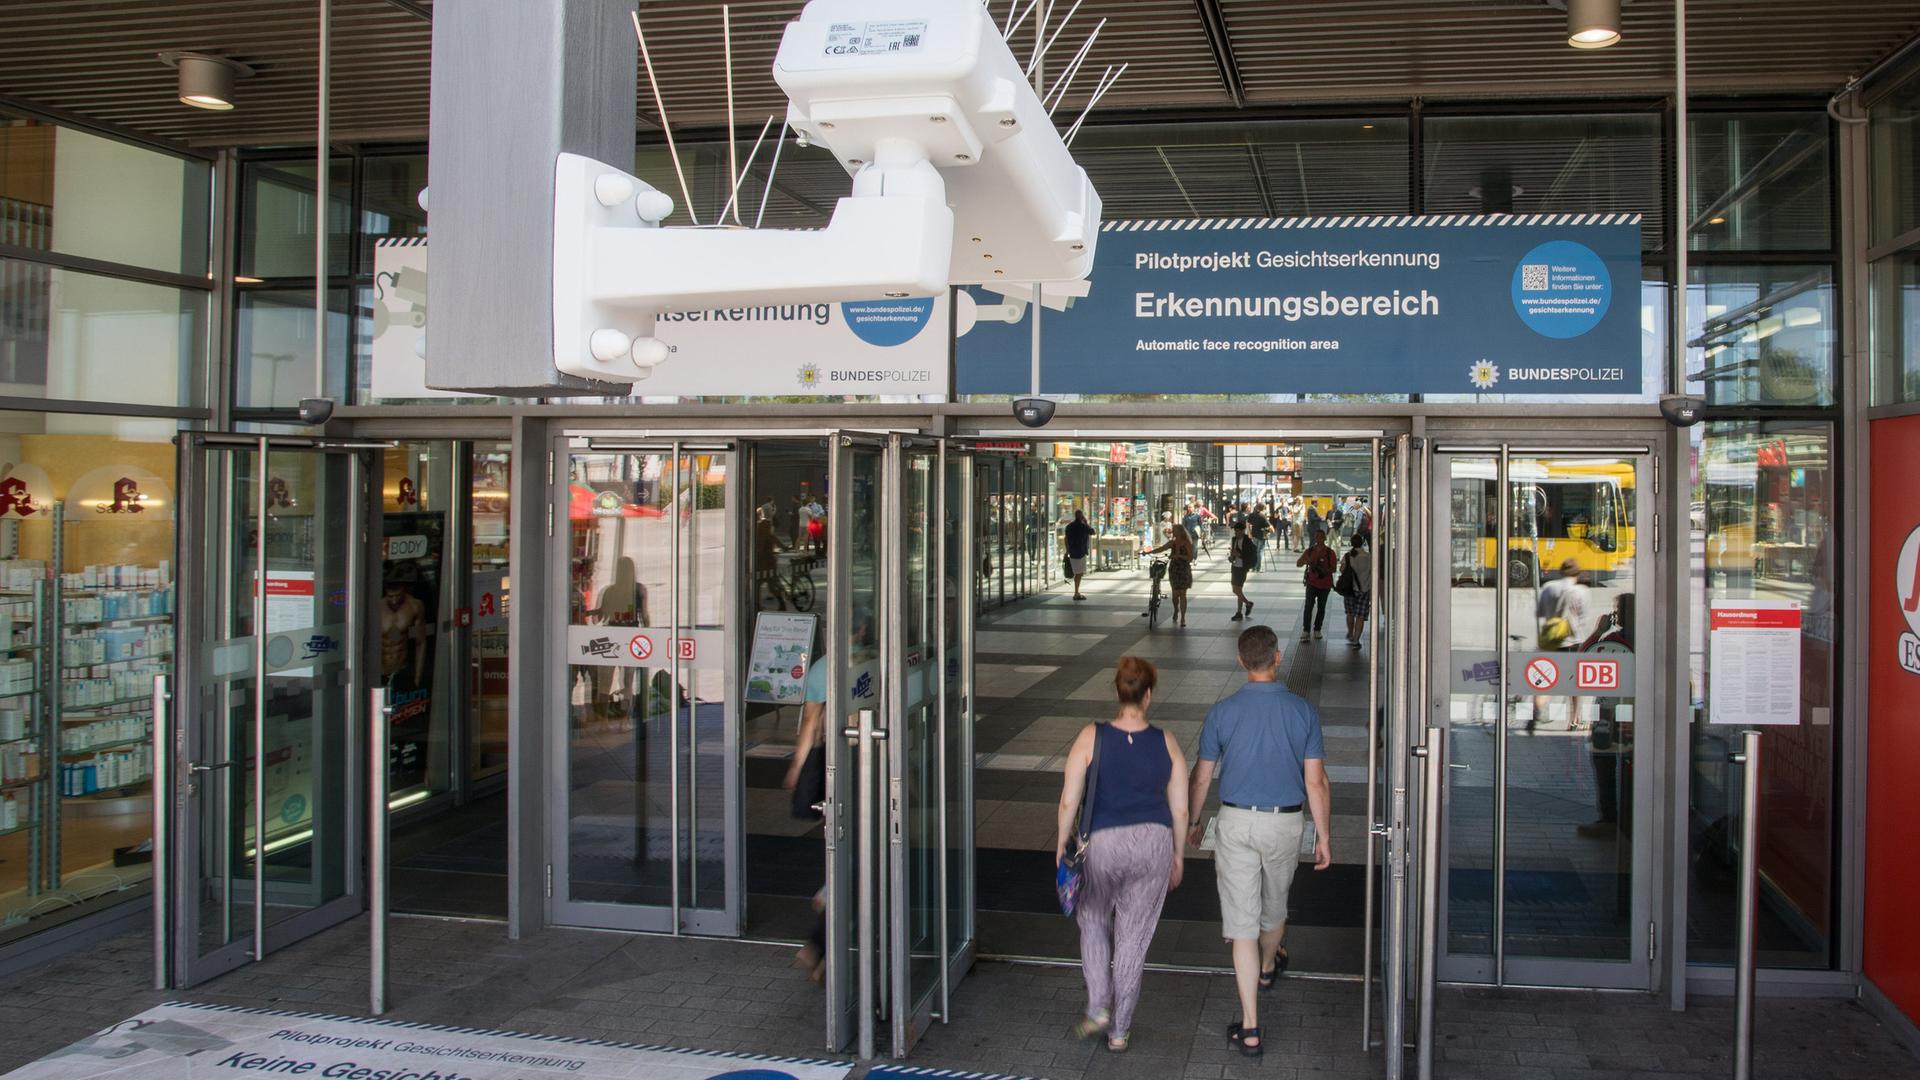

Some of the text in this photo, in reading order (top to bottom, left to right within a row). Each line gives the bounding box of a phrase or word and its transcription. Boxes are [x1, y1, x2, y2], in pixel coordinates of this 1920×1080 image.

[1135, 250, 1441, 272] Pilotprojekt Gesichtserkennung
[1551, 265, 1577, 273] Weitere
[1551, 274, 1596, 282] Informationen
[1551, 283, 1604, 291] finden Sie unter:
[1135, 290, 1440, 322] Erkennungsbereich
[1521, 297, 1602, 306] www.bundespolizei.de/
[849, 305, 926, 314] www.bundespolizei.de/
[1528, 306, 1595, 315] gesichtserkennung
[855, 315, 919, 324] gesichtserkennung
[1135, 338, 1340, 352] Automatic face recognition area
[829, 370, 931, 382] BUNDESPOLIZEI
[1508, 367, 1624, 381] BUNDESPOLIZEI
[390, 541, 422, 556] BODY
[1716, 611, 1758, 620] Hausordnung
[1581, 664, 1614, 685] DB
[268, 1029, 587, 1071] Pilotprojekt Gesichtserkennung
[215, 1051, 318, 1075] Keine
